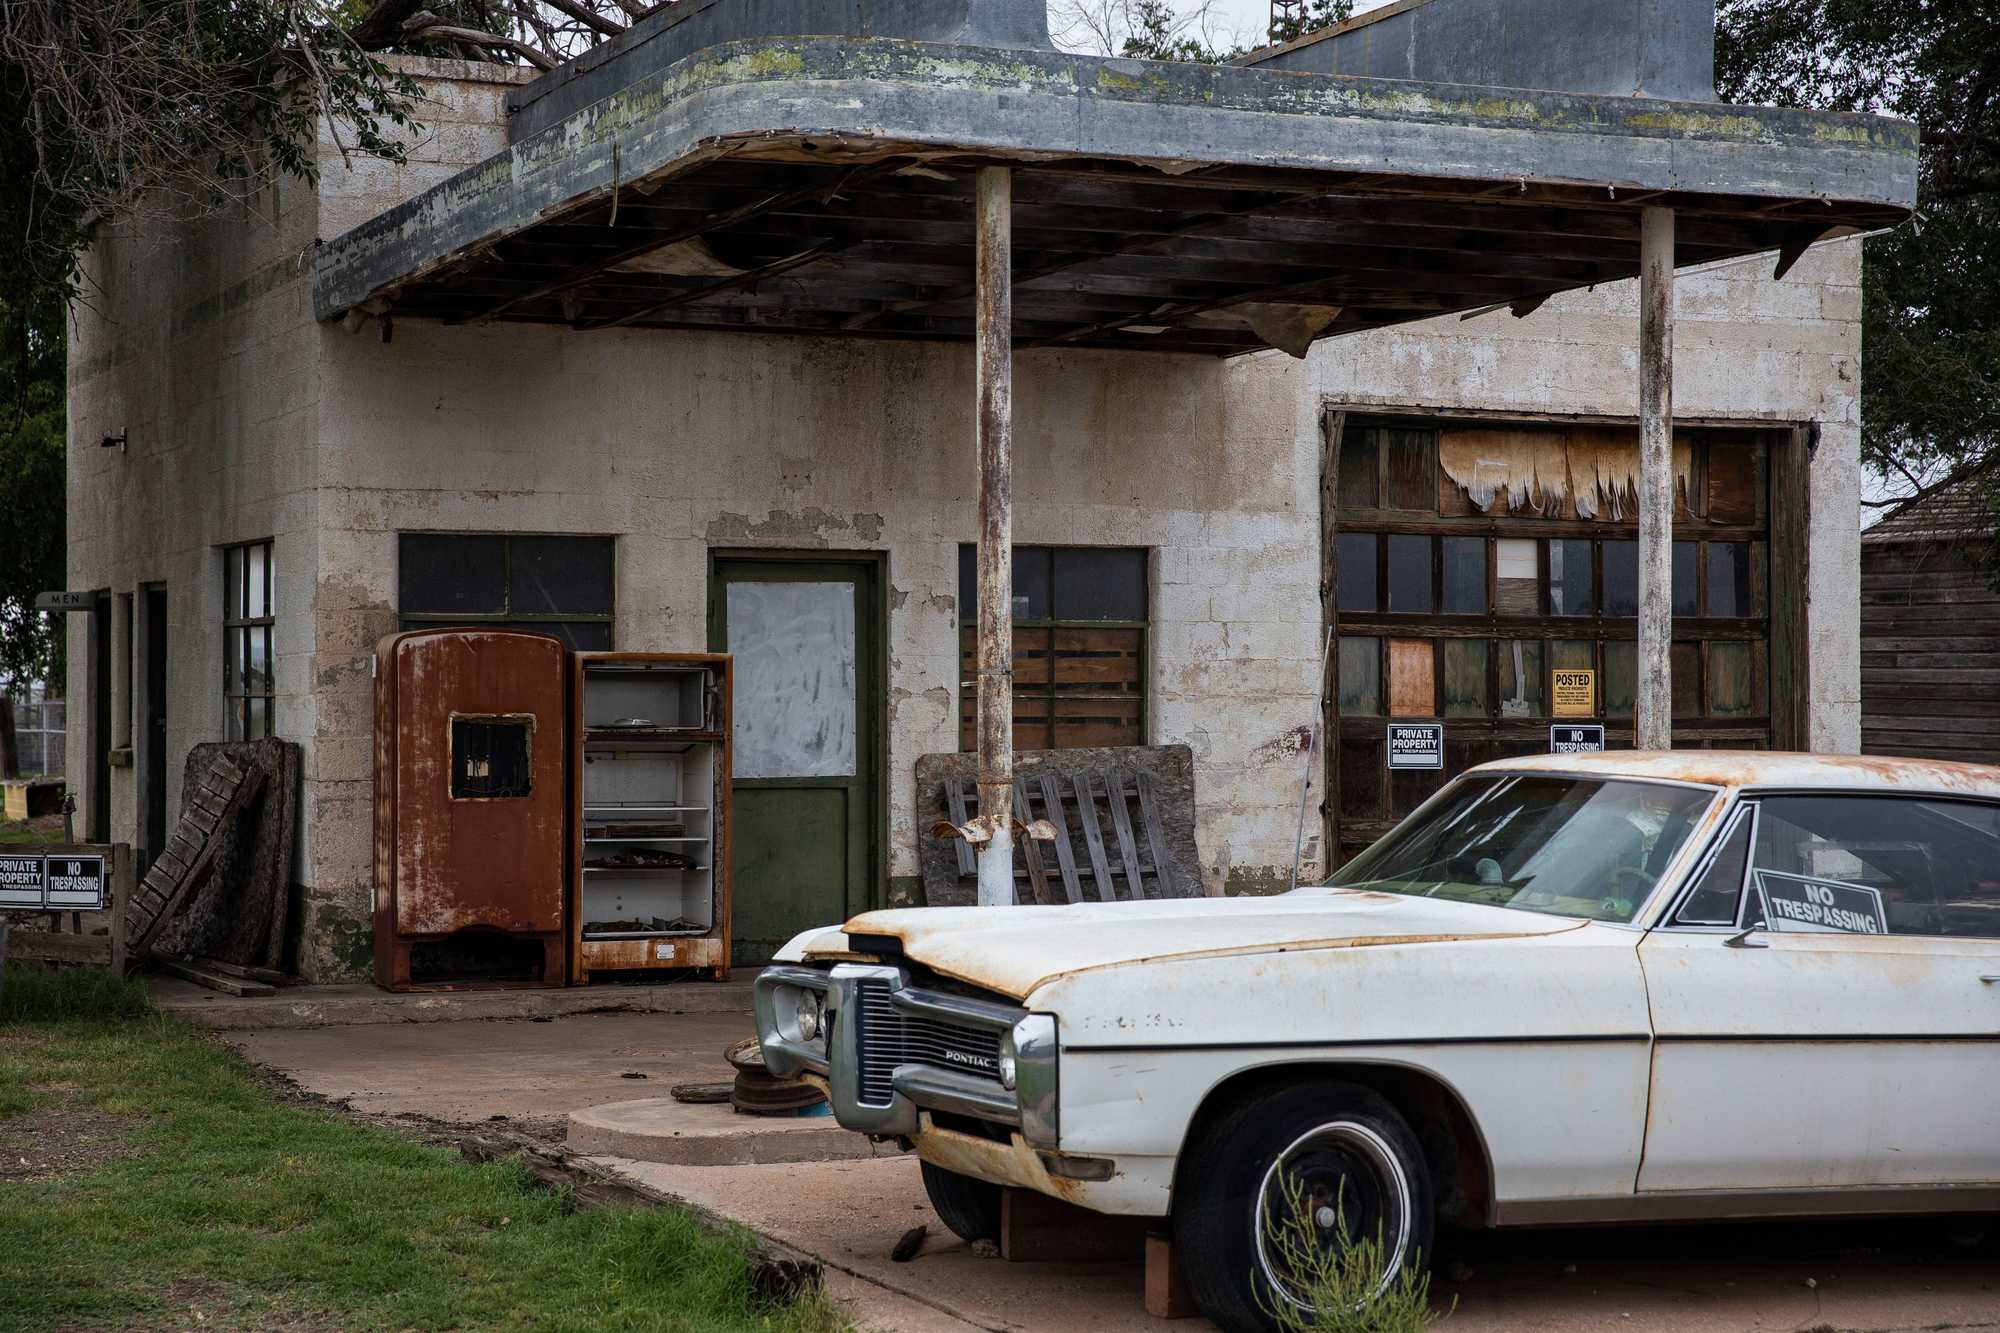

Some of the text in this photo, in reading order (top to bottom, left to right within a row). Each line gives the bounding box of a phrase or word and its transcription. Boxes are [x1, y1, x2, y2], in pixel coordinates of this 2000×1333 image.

[51, 594, 80, 604] MEN
[1556, 674, 1590, 686] POSTED
[1397, 729, 1433, 739] PRIVATE
[1571, 730, 1584, 742] NO
[1392, 739, 1437, 749] PROPERTY
[1556, 742, 1600, 753] TRESPASSING
[0, 860, 37, 872] PRIVATE
[67, 861, 81, 876] NO
[0, 872, 42, 884] ROPERTY
[50, 876, 99, 891] TRESPASSING
[1804, 884, 1835, 906] NO
[1771, 897, 1876, 933] TRESPASSING
[945, 1050, 992, 1067] PONTIAC
